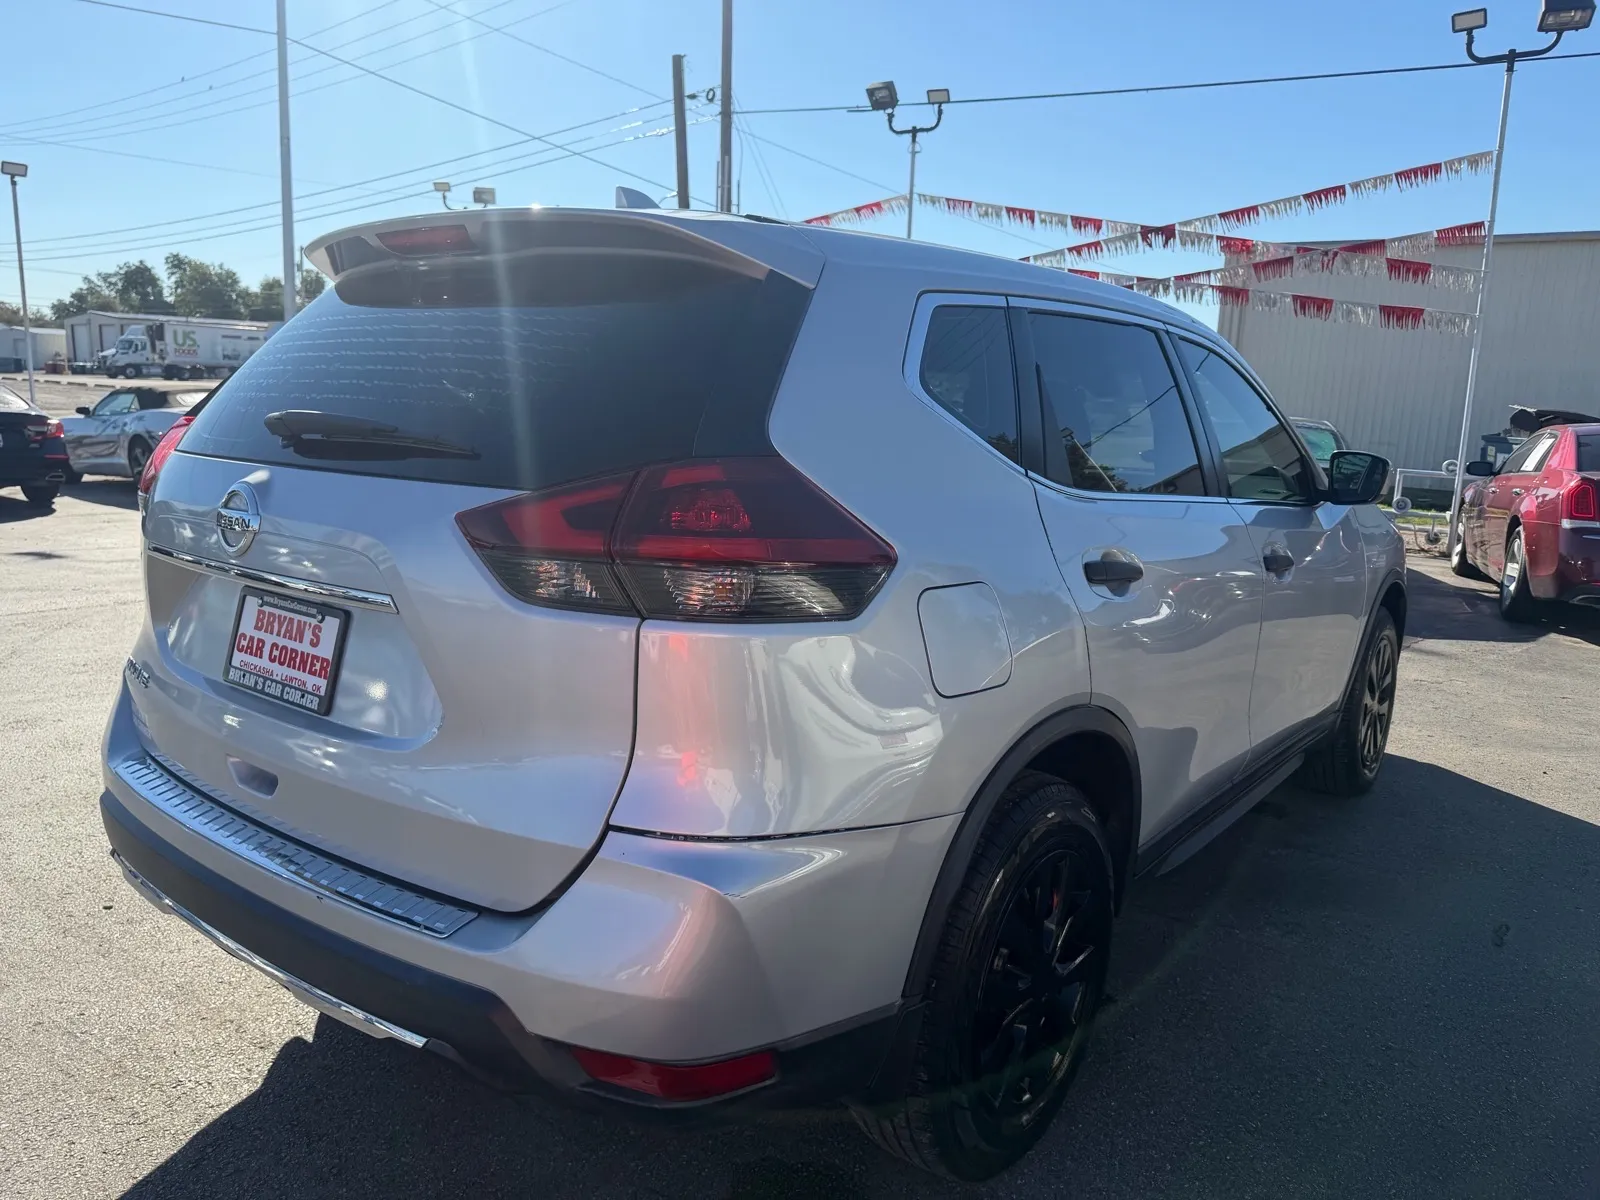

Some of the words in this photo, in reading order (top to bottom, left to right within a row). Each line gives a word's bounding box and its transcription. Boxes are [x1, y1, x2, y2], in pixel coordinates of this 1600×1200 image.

[253, 608, 323, 648] BRYAN'S
[236, 632, 266, 659] CAR
[268, 642, 331, 680] CORNER
[239, 659, 275, 678] CHICKASHA
[311, 683, 323, 693] OK
[228, 668, 264, 690] BRYAN'S
[264, 680, 281, 697] CAR
[283, 686, 320, 710] CORNER
